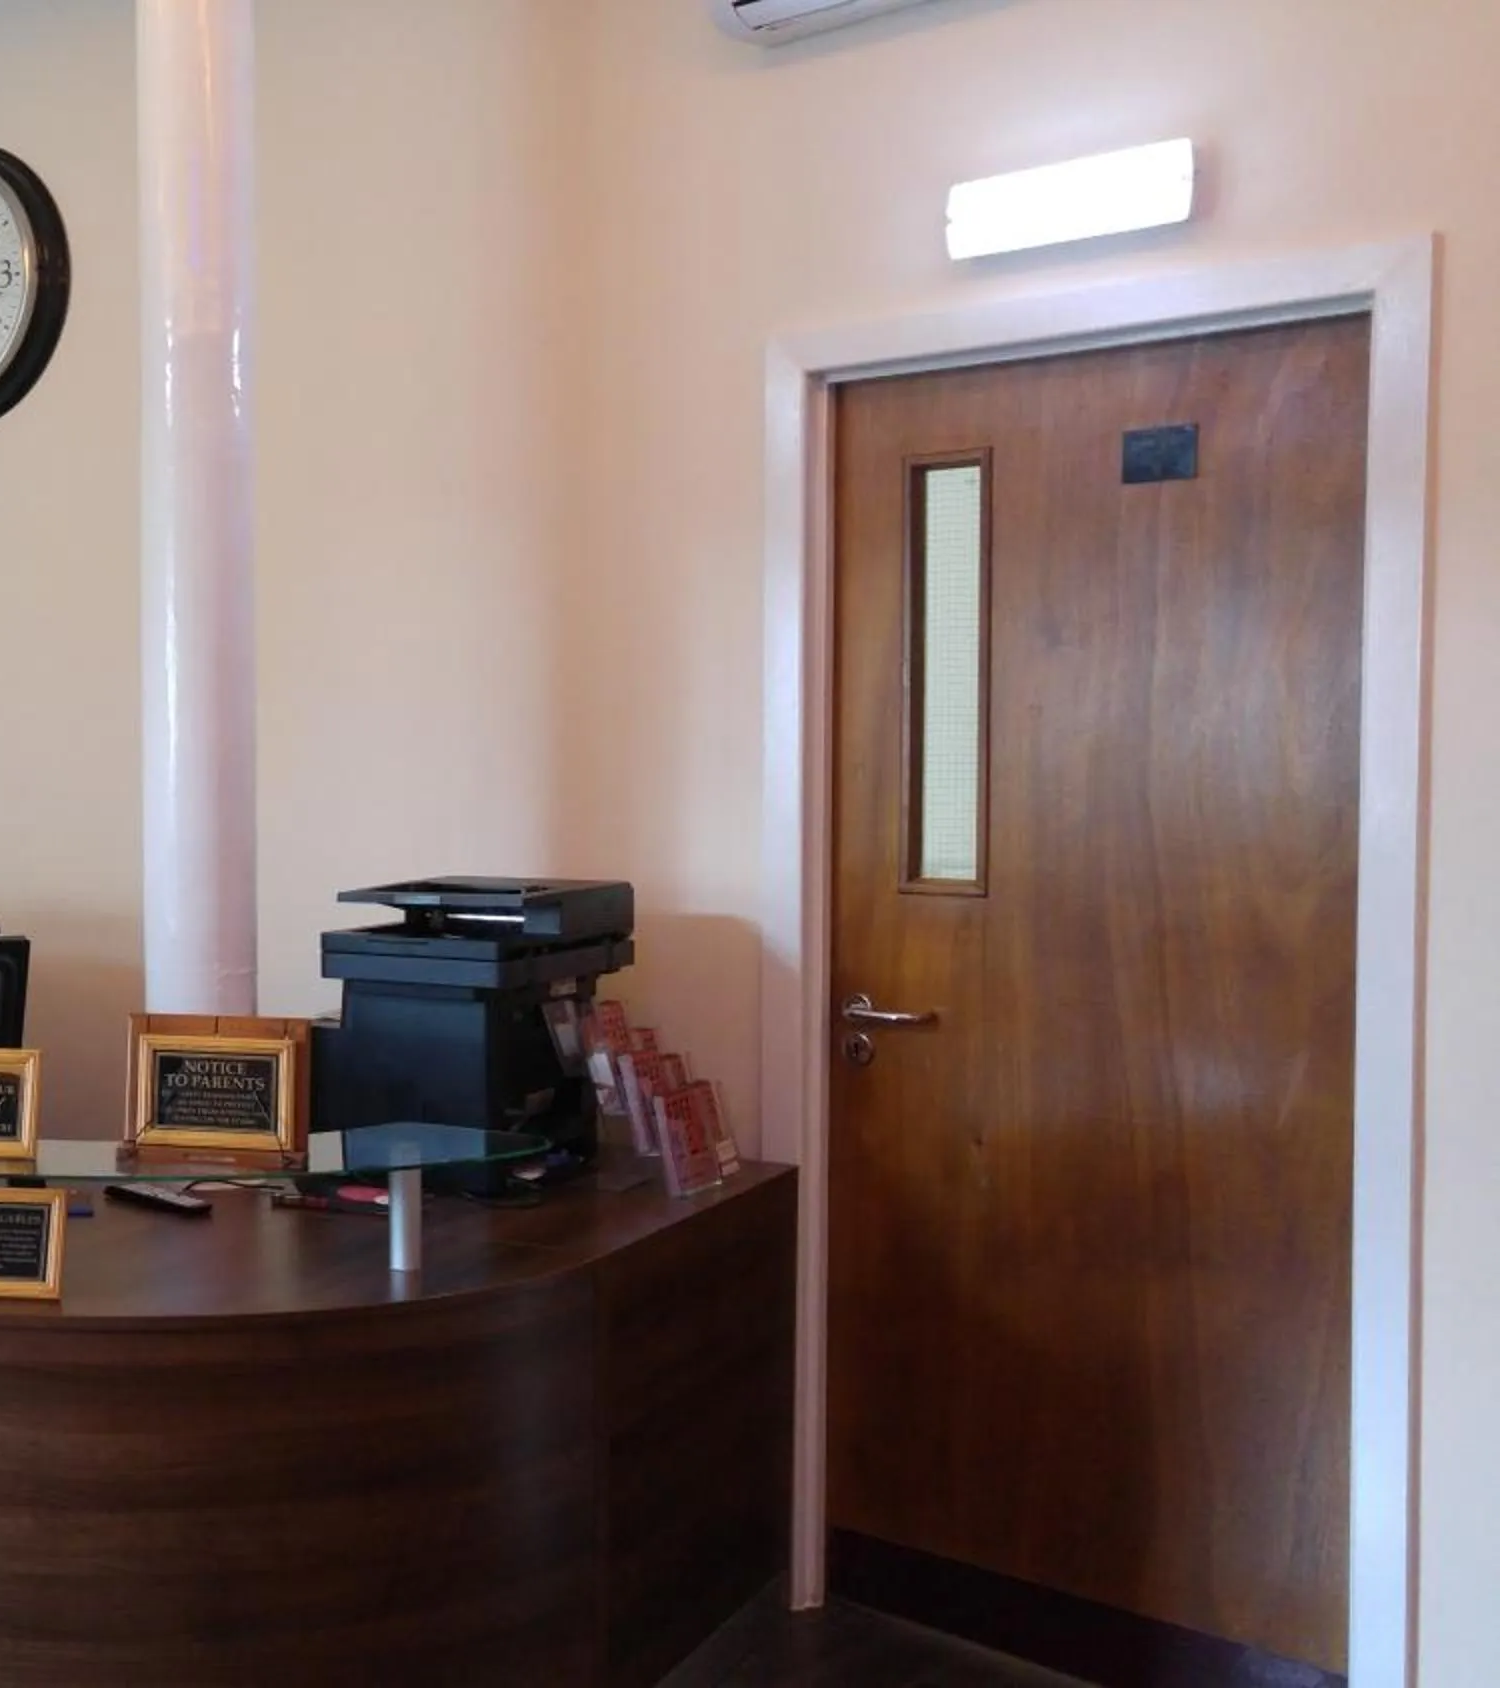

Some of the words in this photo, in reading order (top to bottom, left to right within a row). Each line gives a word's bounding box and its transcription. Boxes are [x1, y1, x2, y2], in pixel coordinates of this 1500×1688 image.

[0, 259, 13, 289] 3
[184, 1059, 247, 1075] NOTICE
[164, 1073, 189, 1087] TO
[192, 1075, 266, 1091] PARENTS
